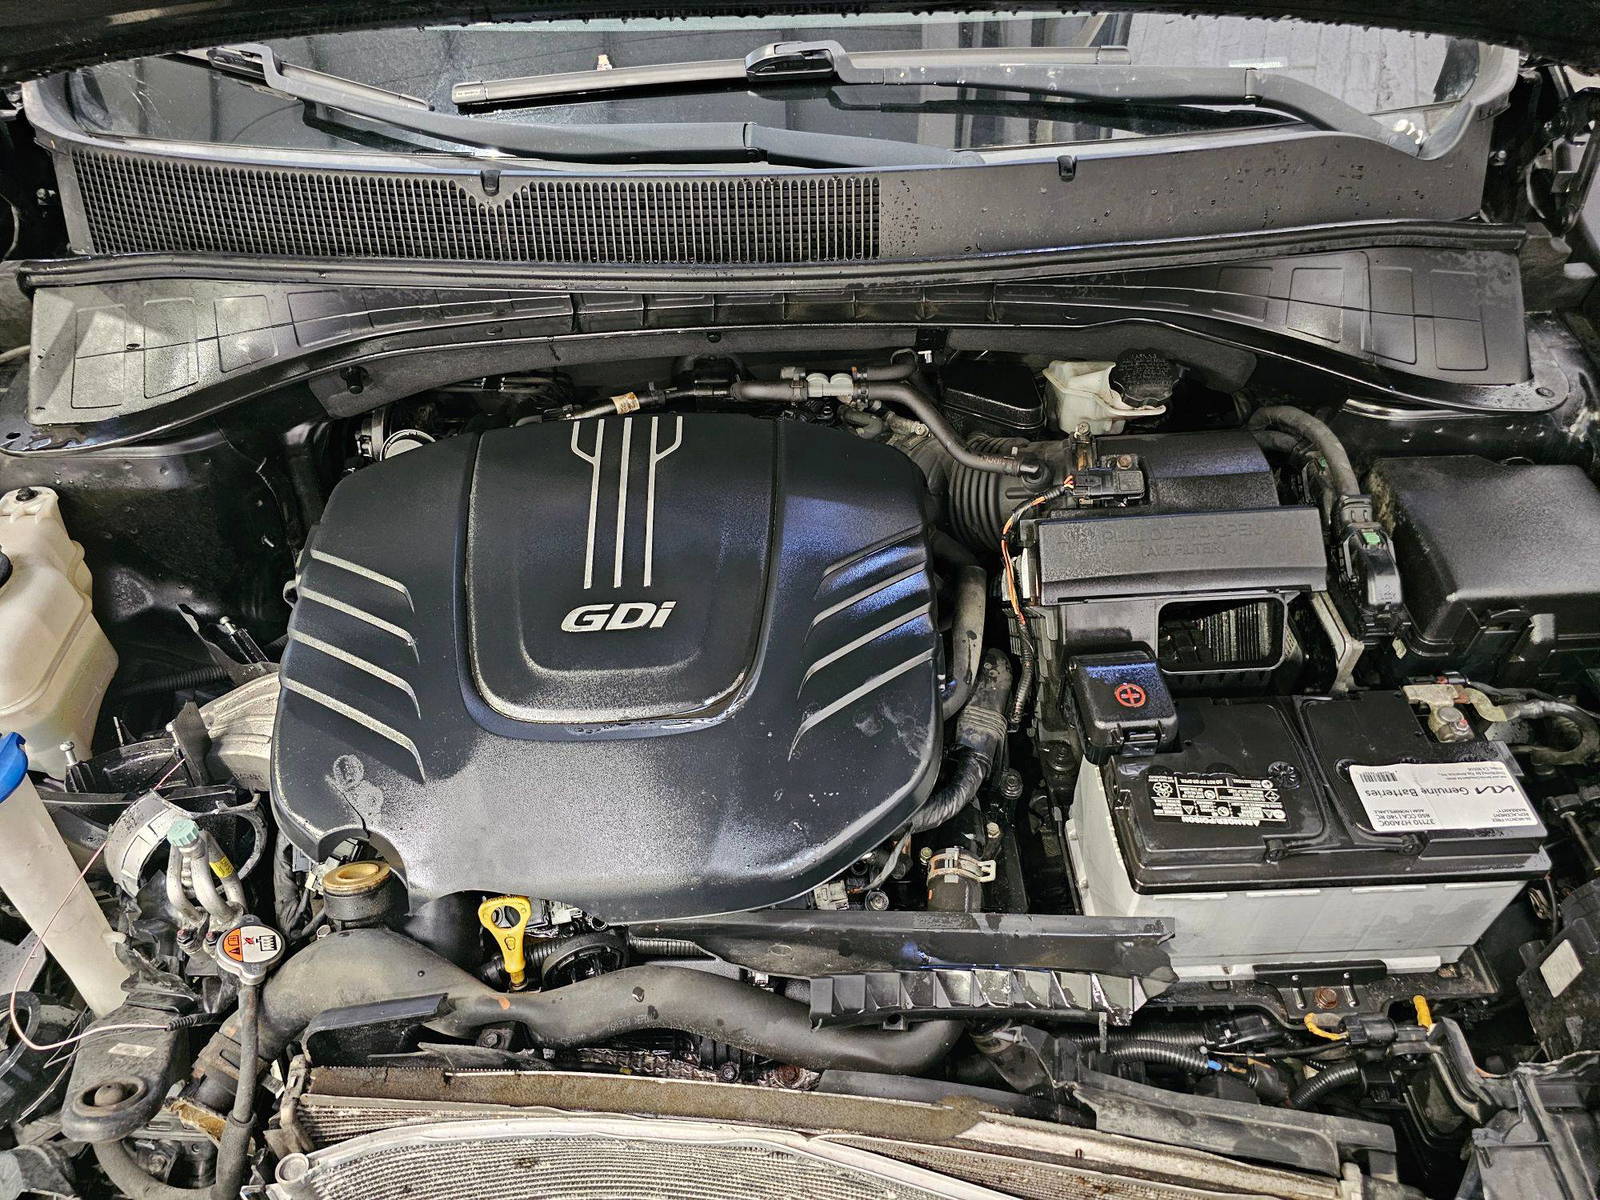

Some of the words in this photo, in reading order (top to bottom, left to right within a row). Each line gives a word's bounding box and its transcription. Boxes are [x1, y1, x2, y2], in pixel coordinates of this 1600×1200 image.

[561, 601, 677, 632] GDi
[1365, 788, 1418, 797] Batteries
[1421, 786, 1469, 796] Genuine
